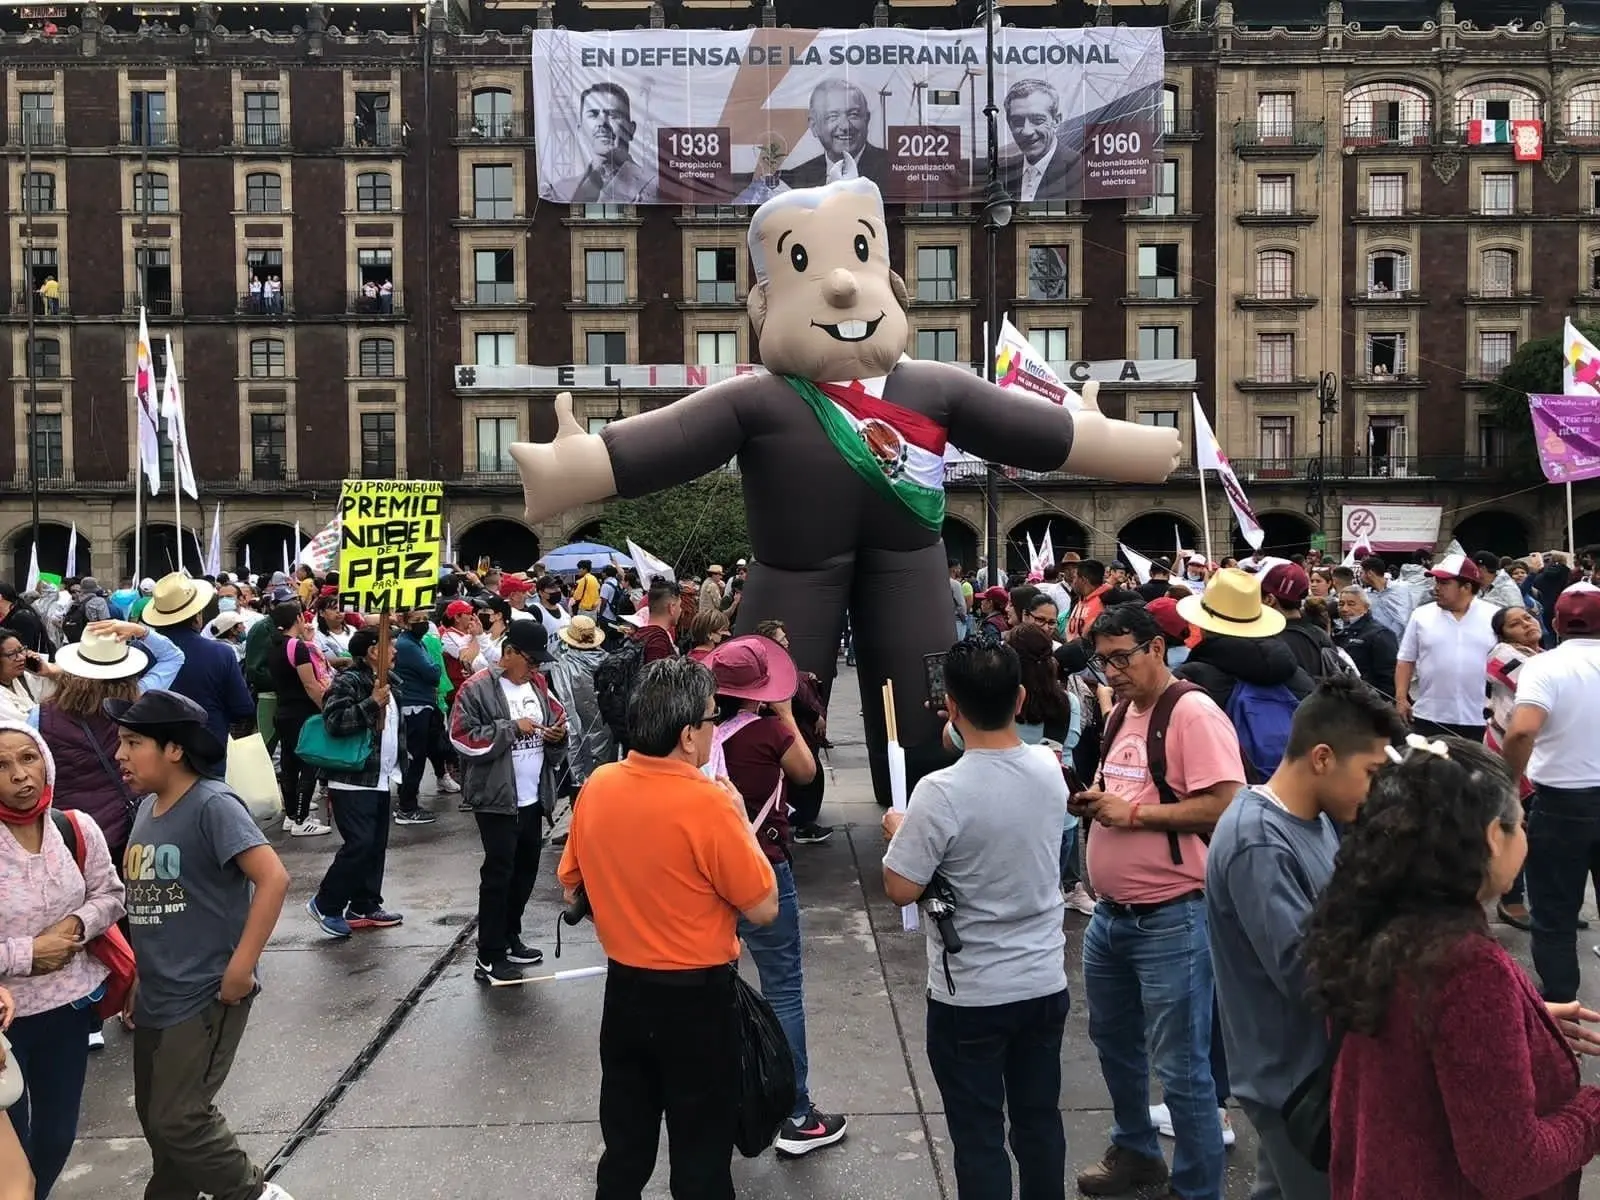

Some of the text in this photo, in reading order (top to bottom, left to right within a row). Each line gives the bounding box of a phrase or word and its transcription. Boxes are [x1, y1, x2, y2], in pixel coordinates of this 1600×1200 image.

[581, 39, 1119, 67] EN DEFENSA DE LA SOBERANÍA NACIONAL
[668, 133, 720, 156] 1938
[897, 134, 949, 157] 2022
[1091, 131, 1141, 155] 1960
[670, 160, 722, 169] Expropiación
[892, 163, 955, 171] Nacionalización
[1087, 158, 1150, 168] Nacionalización
[679, 171, 715, 179] petrolera
[907, 173, 940, 181] del Litio
[344, 481, 362, 494] YO
[341, 495, 441, 520] PREMIO
[341, 519, 444, 550] NOBEL
[377, 543, 413, 556] DE LA
[348, 552, 433, 588] PAZ
[372, 579, 399, 590] PARA
[339, 583, 438, 615] AMLO
[123, 843, 181, 881] 020
